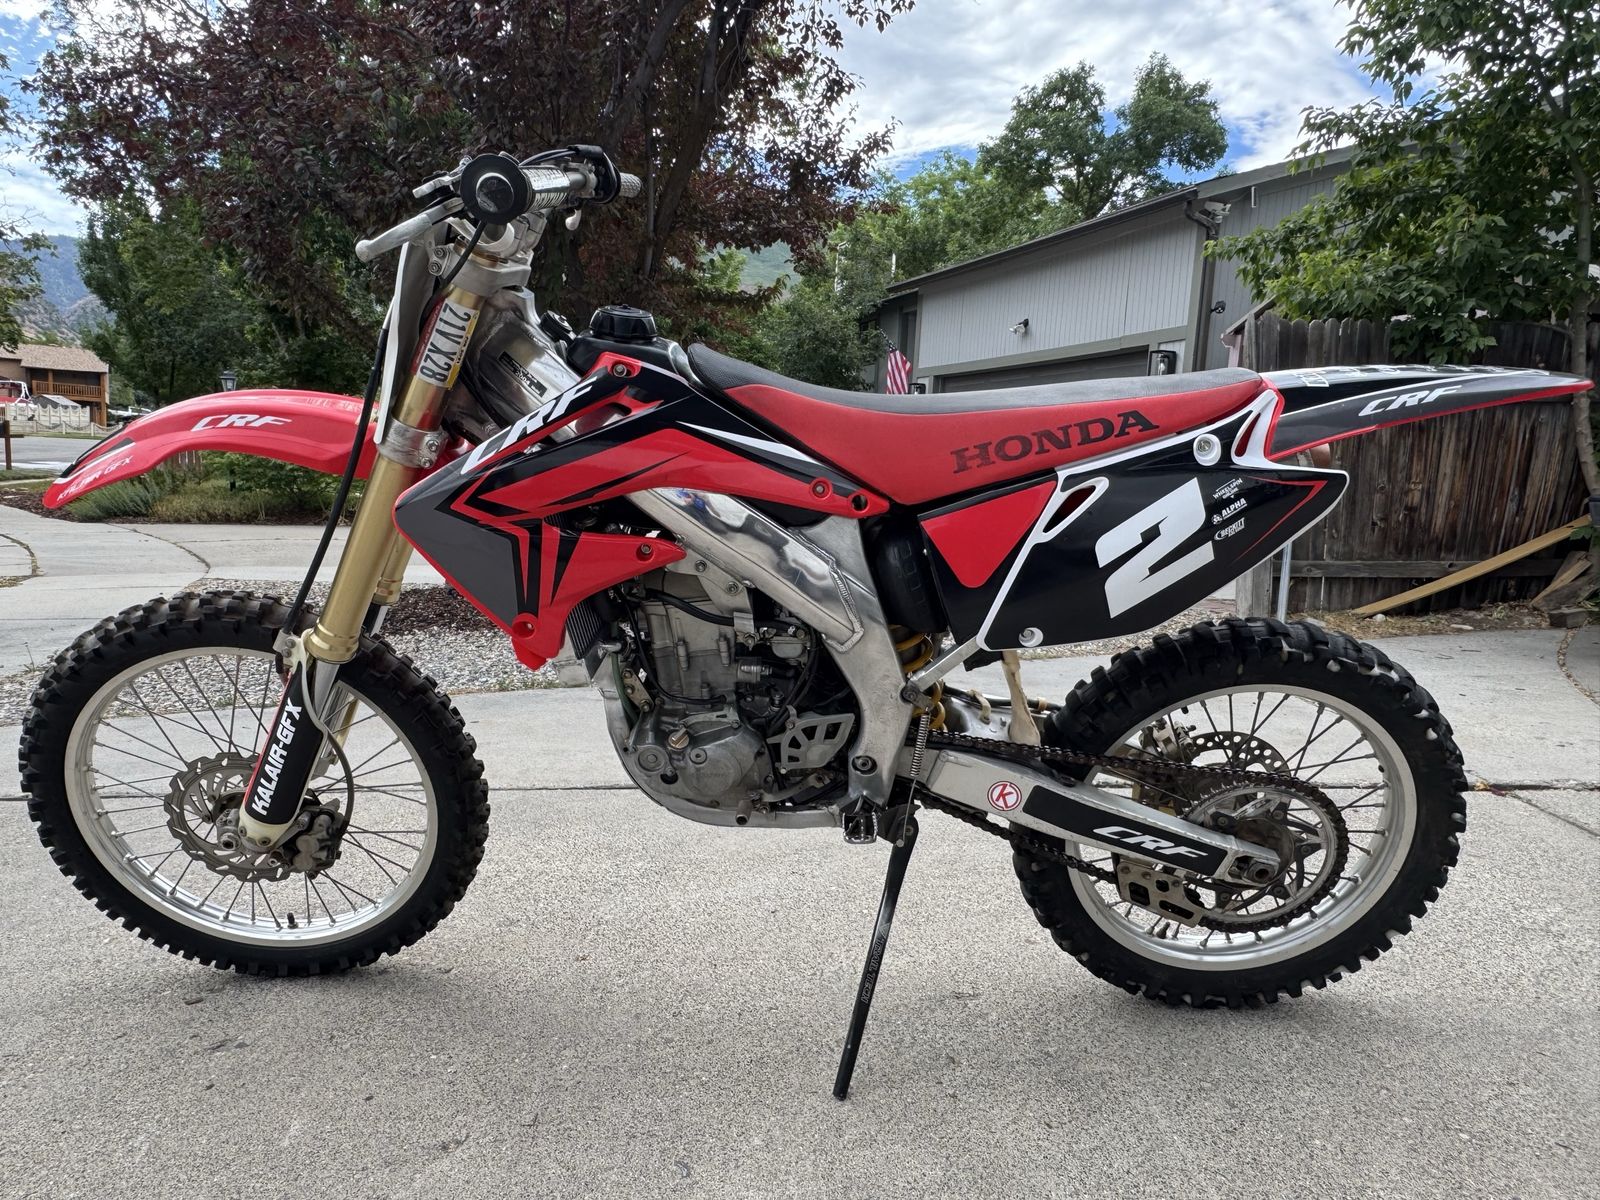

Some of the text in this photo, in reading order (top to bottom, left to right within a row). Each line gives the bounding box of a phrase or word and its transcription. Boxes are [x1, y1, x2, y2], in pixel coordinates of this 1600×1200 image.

[190, 413, 293, 432] CRF
[460, 375, 598, 475] CRF
[1358, 385, 1463, 417] CRF
[950, 409, 1161, 474] HONDA
[1222, 498, 1247, 517] ALPHA
[1095, 476, 1215, 619] 2
[251, 696, 303, 816] KALAIR-GFX
[1092, 826, 1209, 858] CRF
